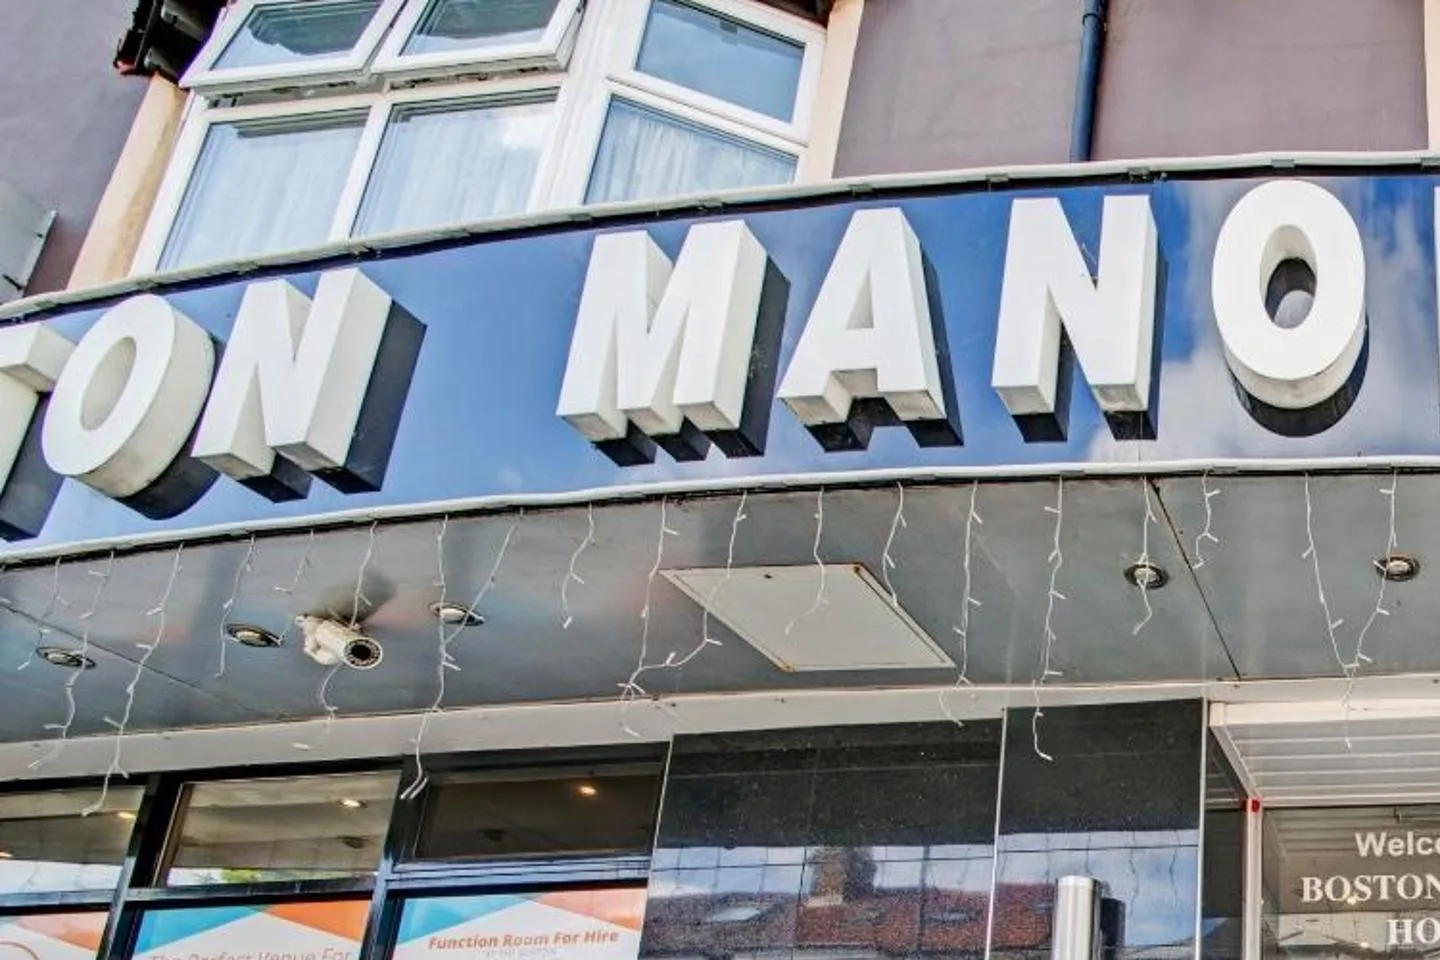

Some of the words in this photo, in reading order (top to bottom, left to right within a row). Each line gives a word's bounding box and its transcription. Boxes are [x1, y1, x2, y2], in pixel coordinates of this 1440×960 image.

[428, 934, 499, 950] Function
[502, 933, 549, 948] Room
[552, 930, 580, 946] For
[584, 928, 620, 944] Hire
